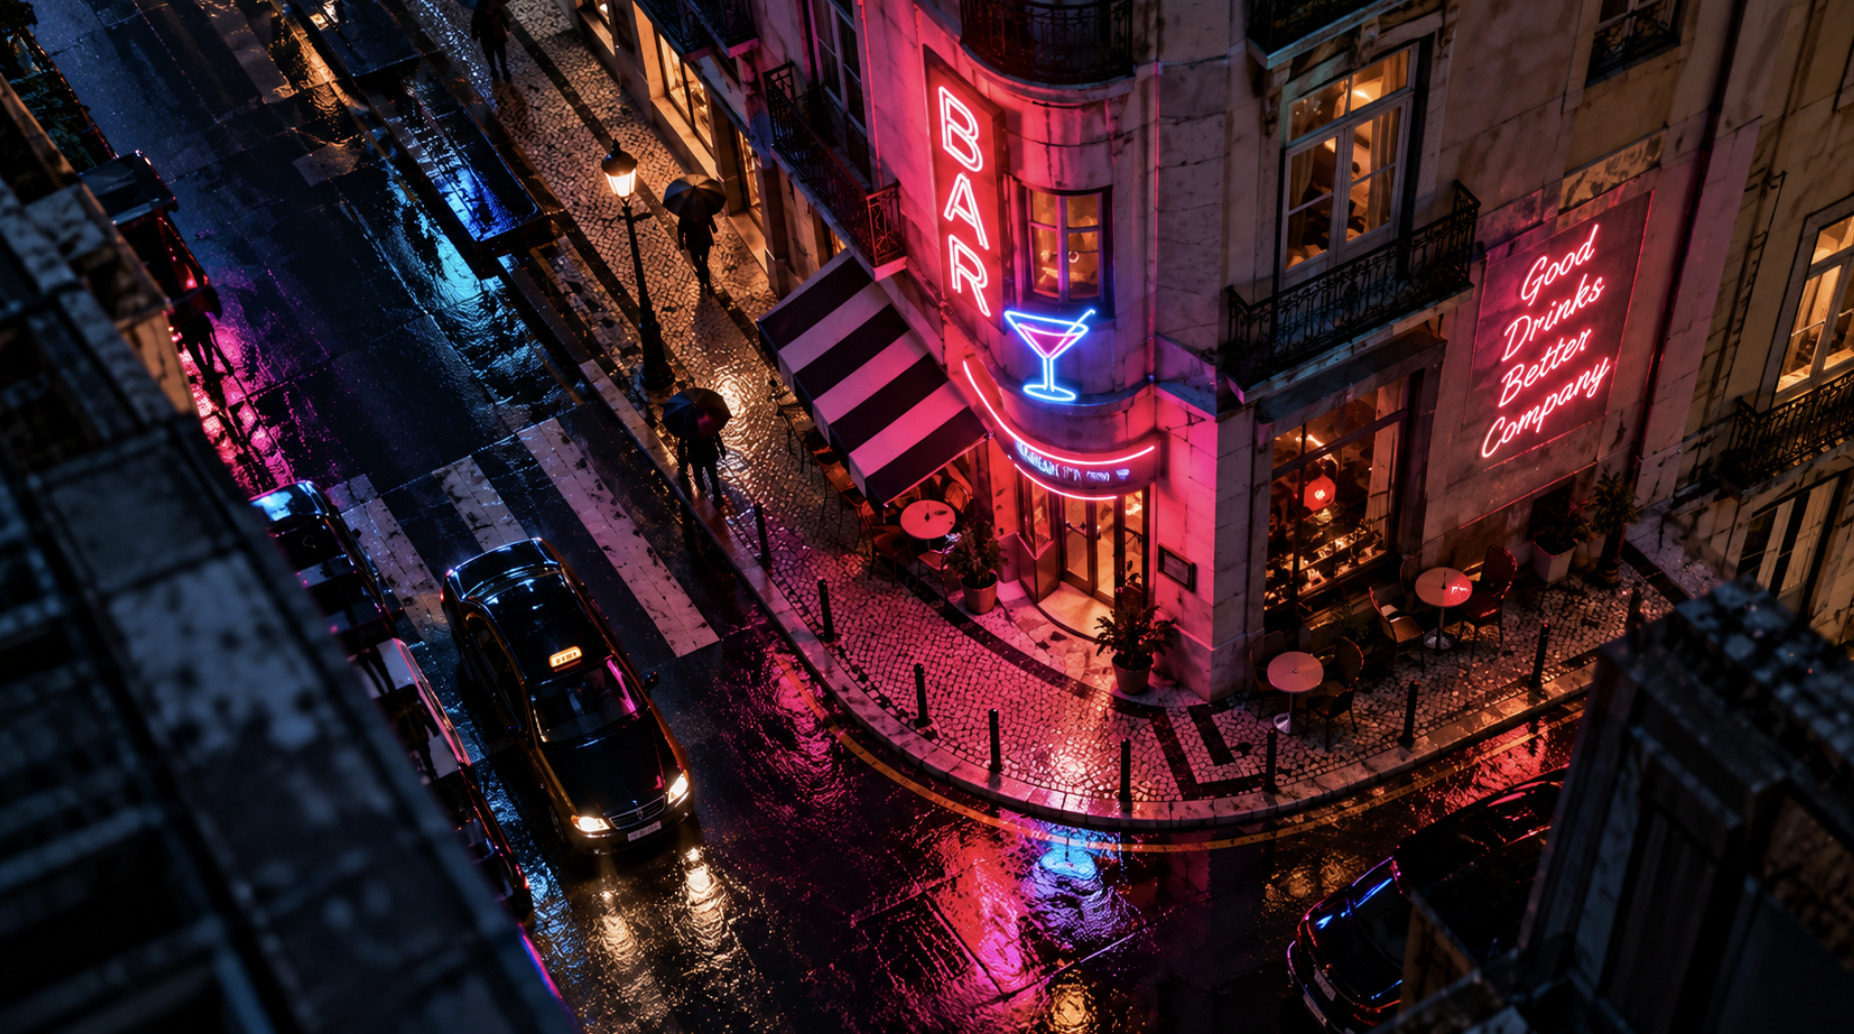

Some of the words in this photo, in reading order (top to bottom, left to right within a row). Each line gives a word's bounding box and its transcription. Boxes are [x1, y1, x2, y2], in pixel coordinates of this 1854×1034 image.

[938, 86, 991, 317] BAR
[1520, 223, 1599, 307] Good
[1500, 273, 1606, 362] Drinks
[1481, 357, 1611, 459] Company
[1498, 328, 1593, 408] Better
